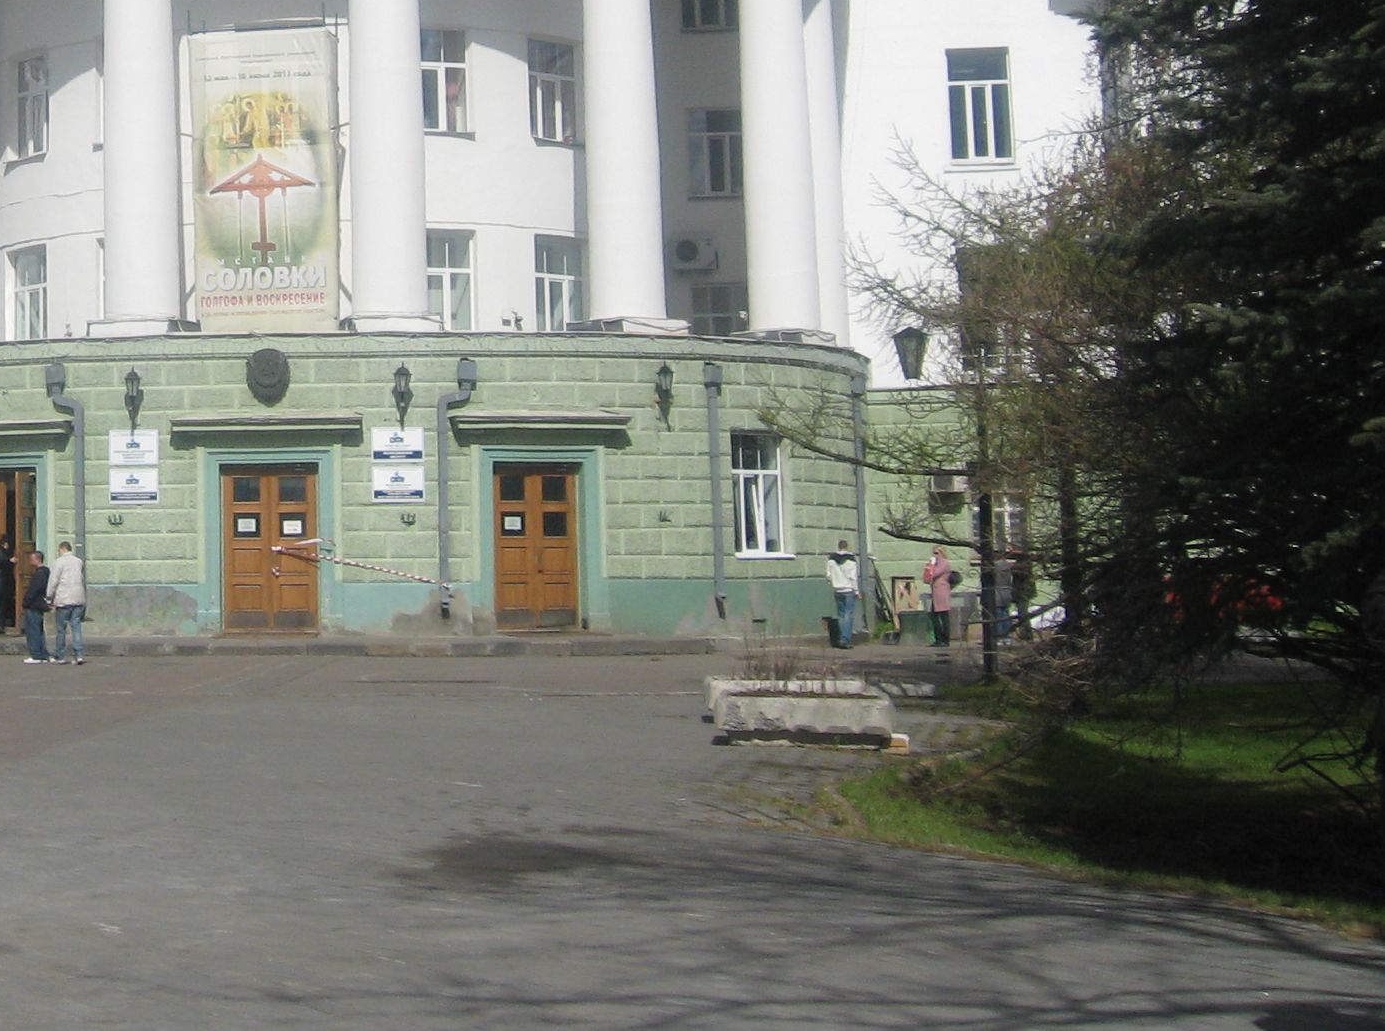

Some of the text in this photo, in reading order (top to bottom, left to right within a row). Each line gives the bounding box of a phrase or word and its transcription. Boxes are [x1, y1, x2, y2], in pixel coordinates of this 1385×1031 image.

[201, 266, 327, 292] СОЛОВКИ
[200, 292, 325, 308] ГОЛГОФА И ВОСКРЕСЕНИЕ
